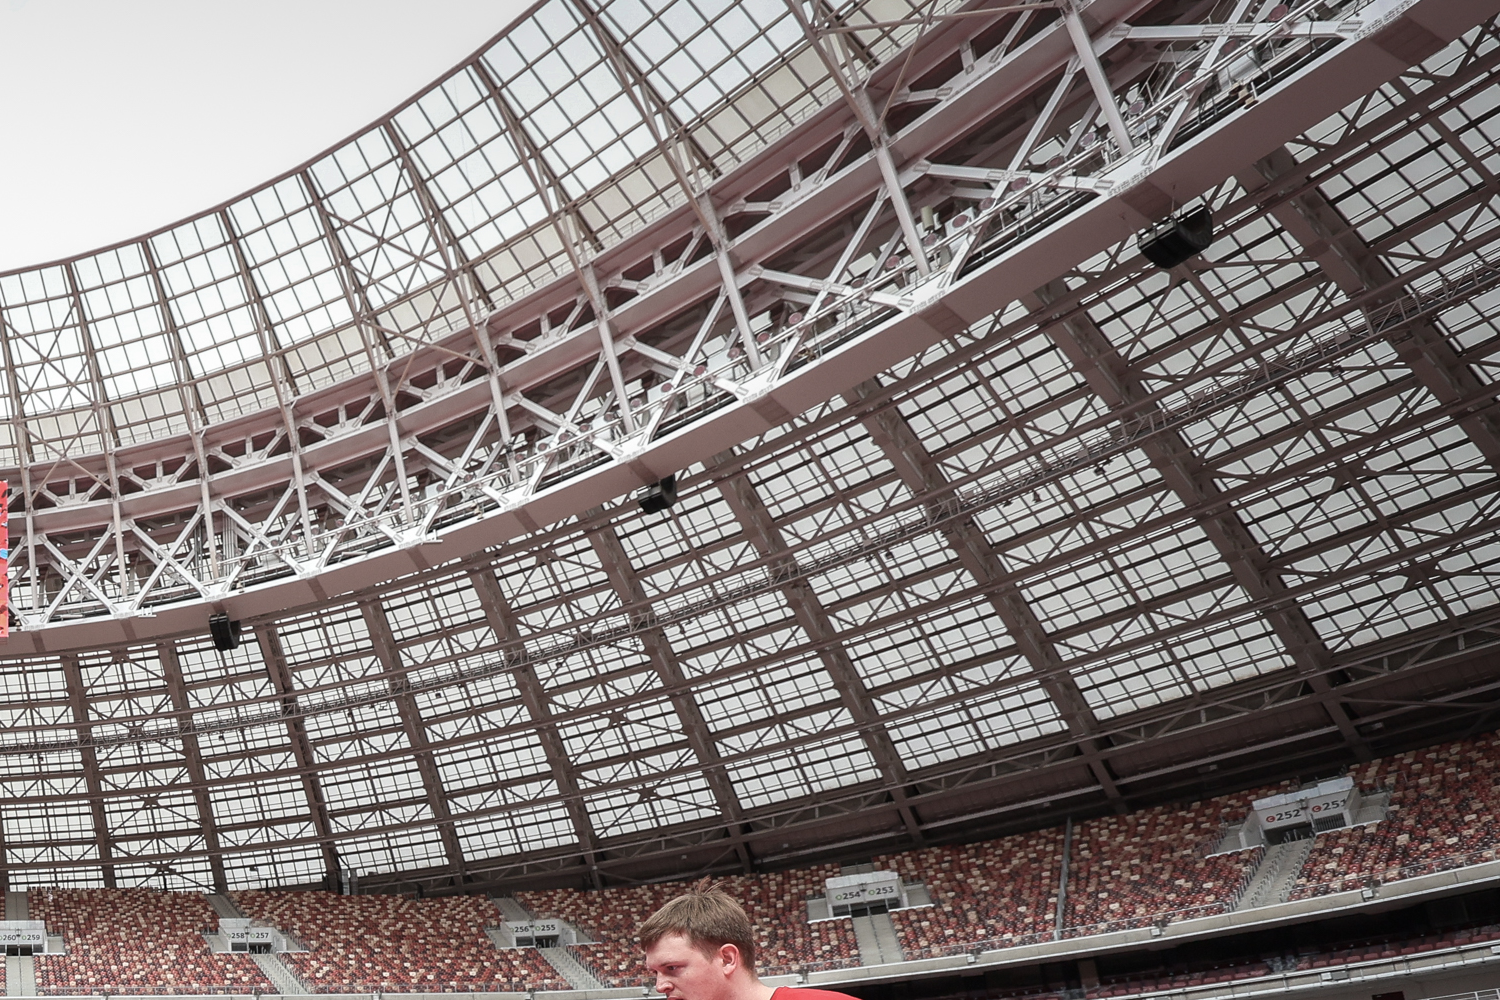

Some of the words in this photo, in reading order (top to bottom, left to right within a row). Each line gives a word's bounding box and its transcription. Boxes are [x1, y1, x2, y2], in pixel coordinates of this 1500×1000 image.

[1275, 809, 1301, 821] 252
[842, 891, 861, 900] 254
[875, 886, 894, 895] 253
